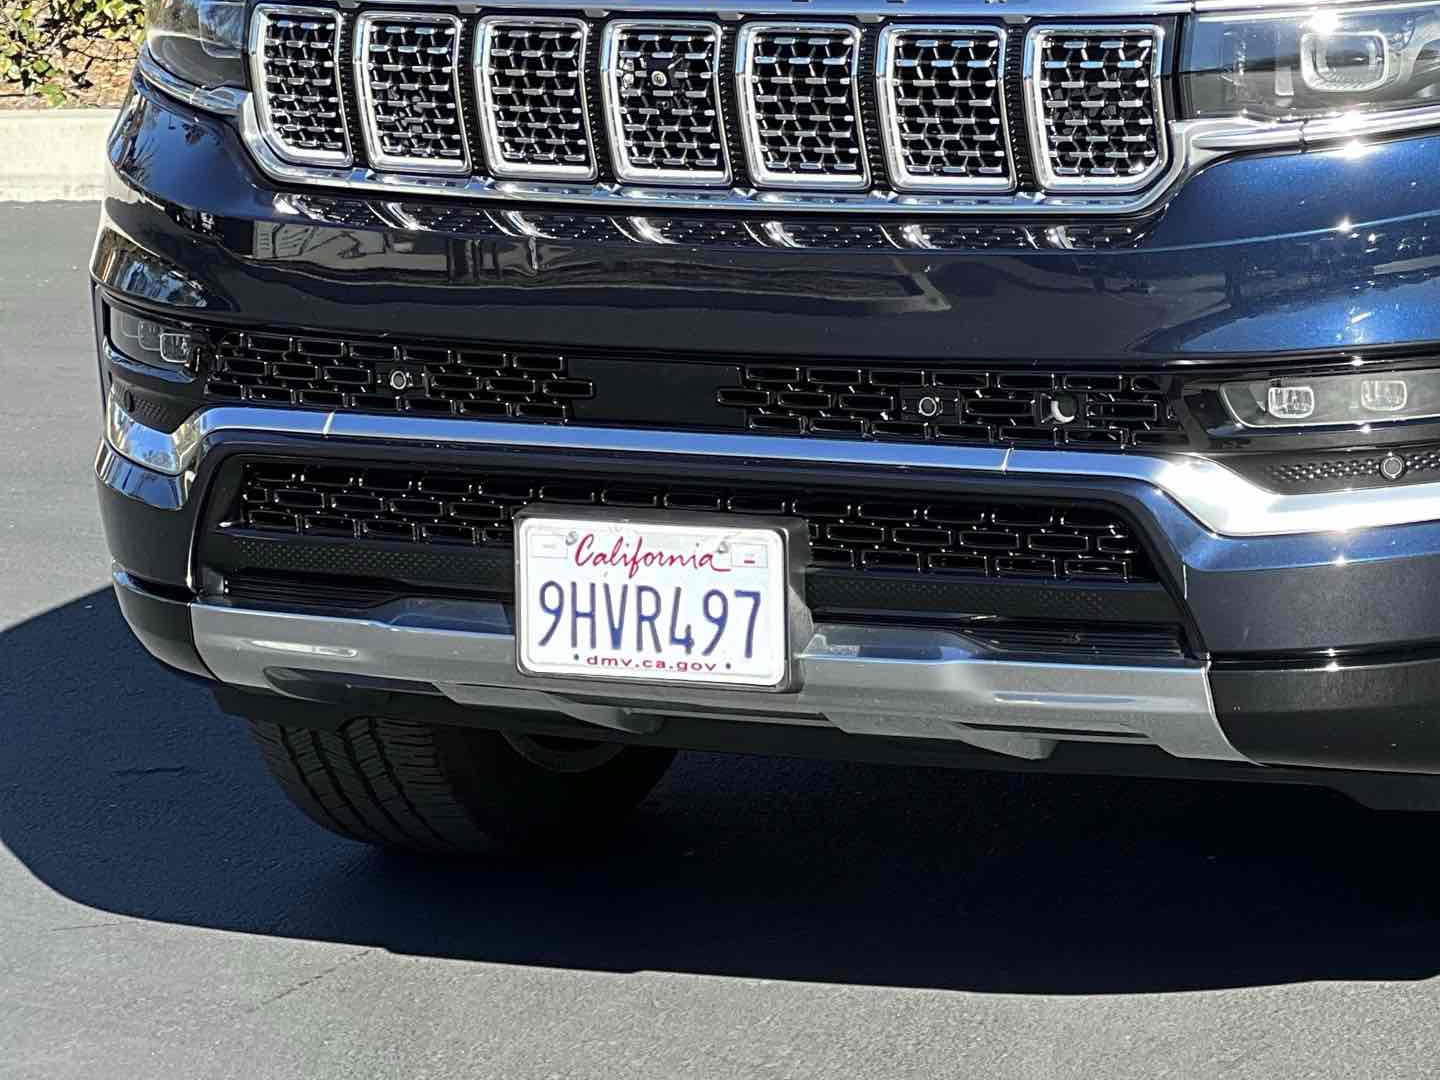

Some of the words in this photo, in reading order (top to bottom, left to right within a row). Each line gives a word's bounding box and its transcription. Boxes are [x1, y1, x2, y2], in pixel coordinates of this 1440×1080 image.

[574, 533, 732, 579] California
[538, 580, 761, 659] 9HVR497
[586, 653, 717, 672] dmv.ca.gov
